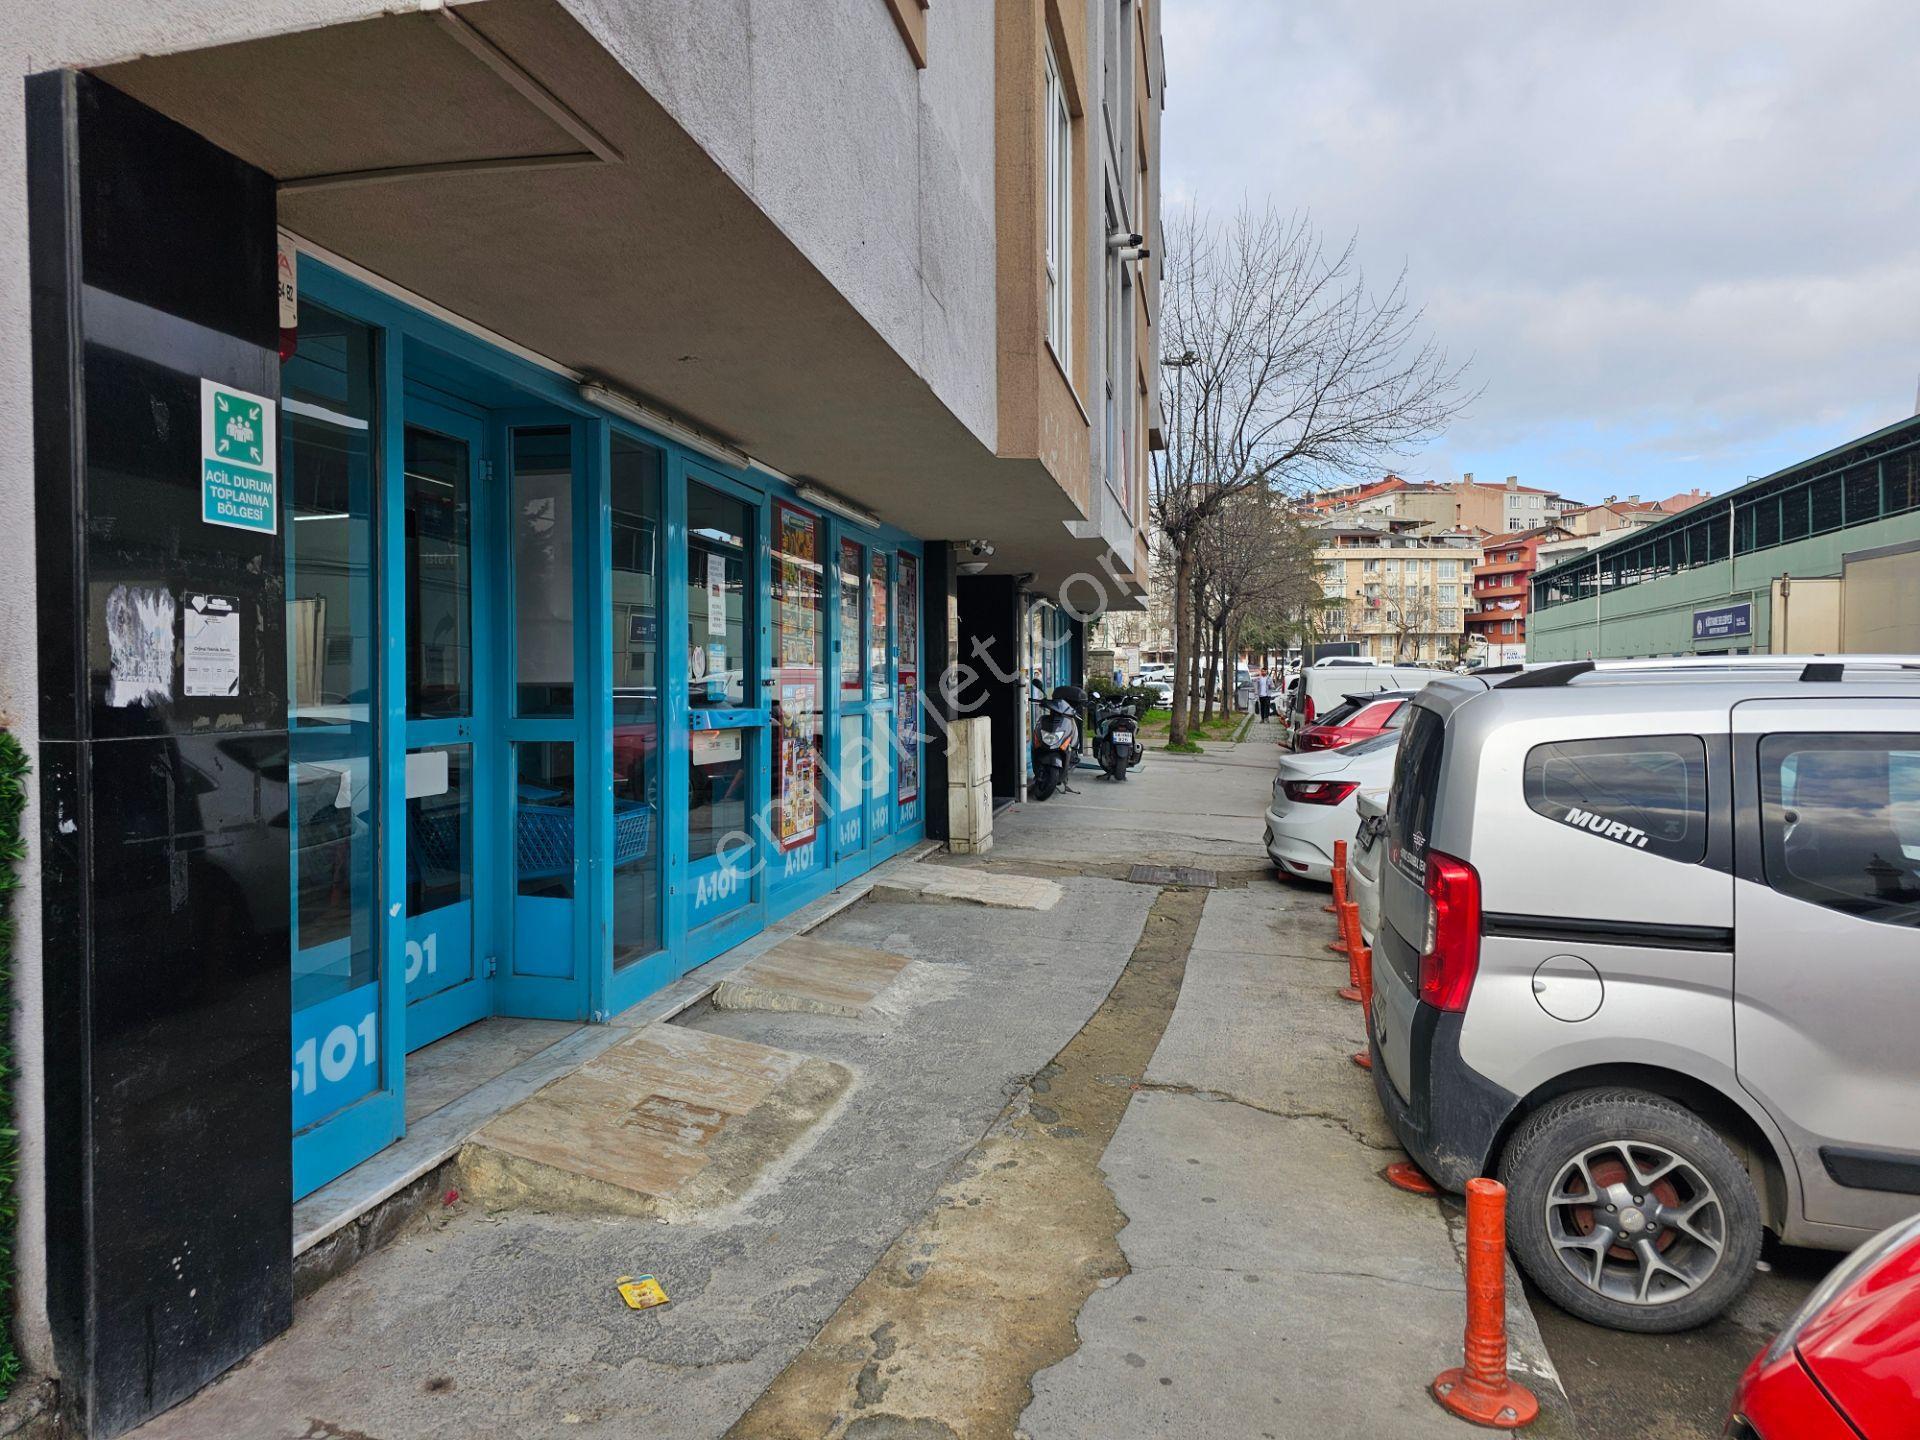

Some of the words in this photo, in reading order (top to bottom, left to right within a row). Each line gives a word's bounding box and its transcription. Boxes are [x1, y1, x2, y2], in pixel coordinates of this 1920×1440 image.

[205, 469, 231, 486] ACİL
[233, 475, 273, 494] DURUM
[209, 485, 270, 508] TOPLANMA
[217, 501, 263, 521] BÖLGESİ
